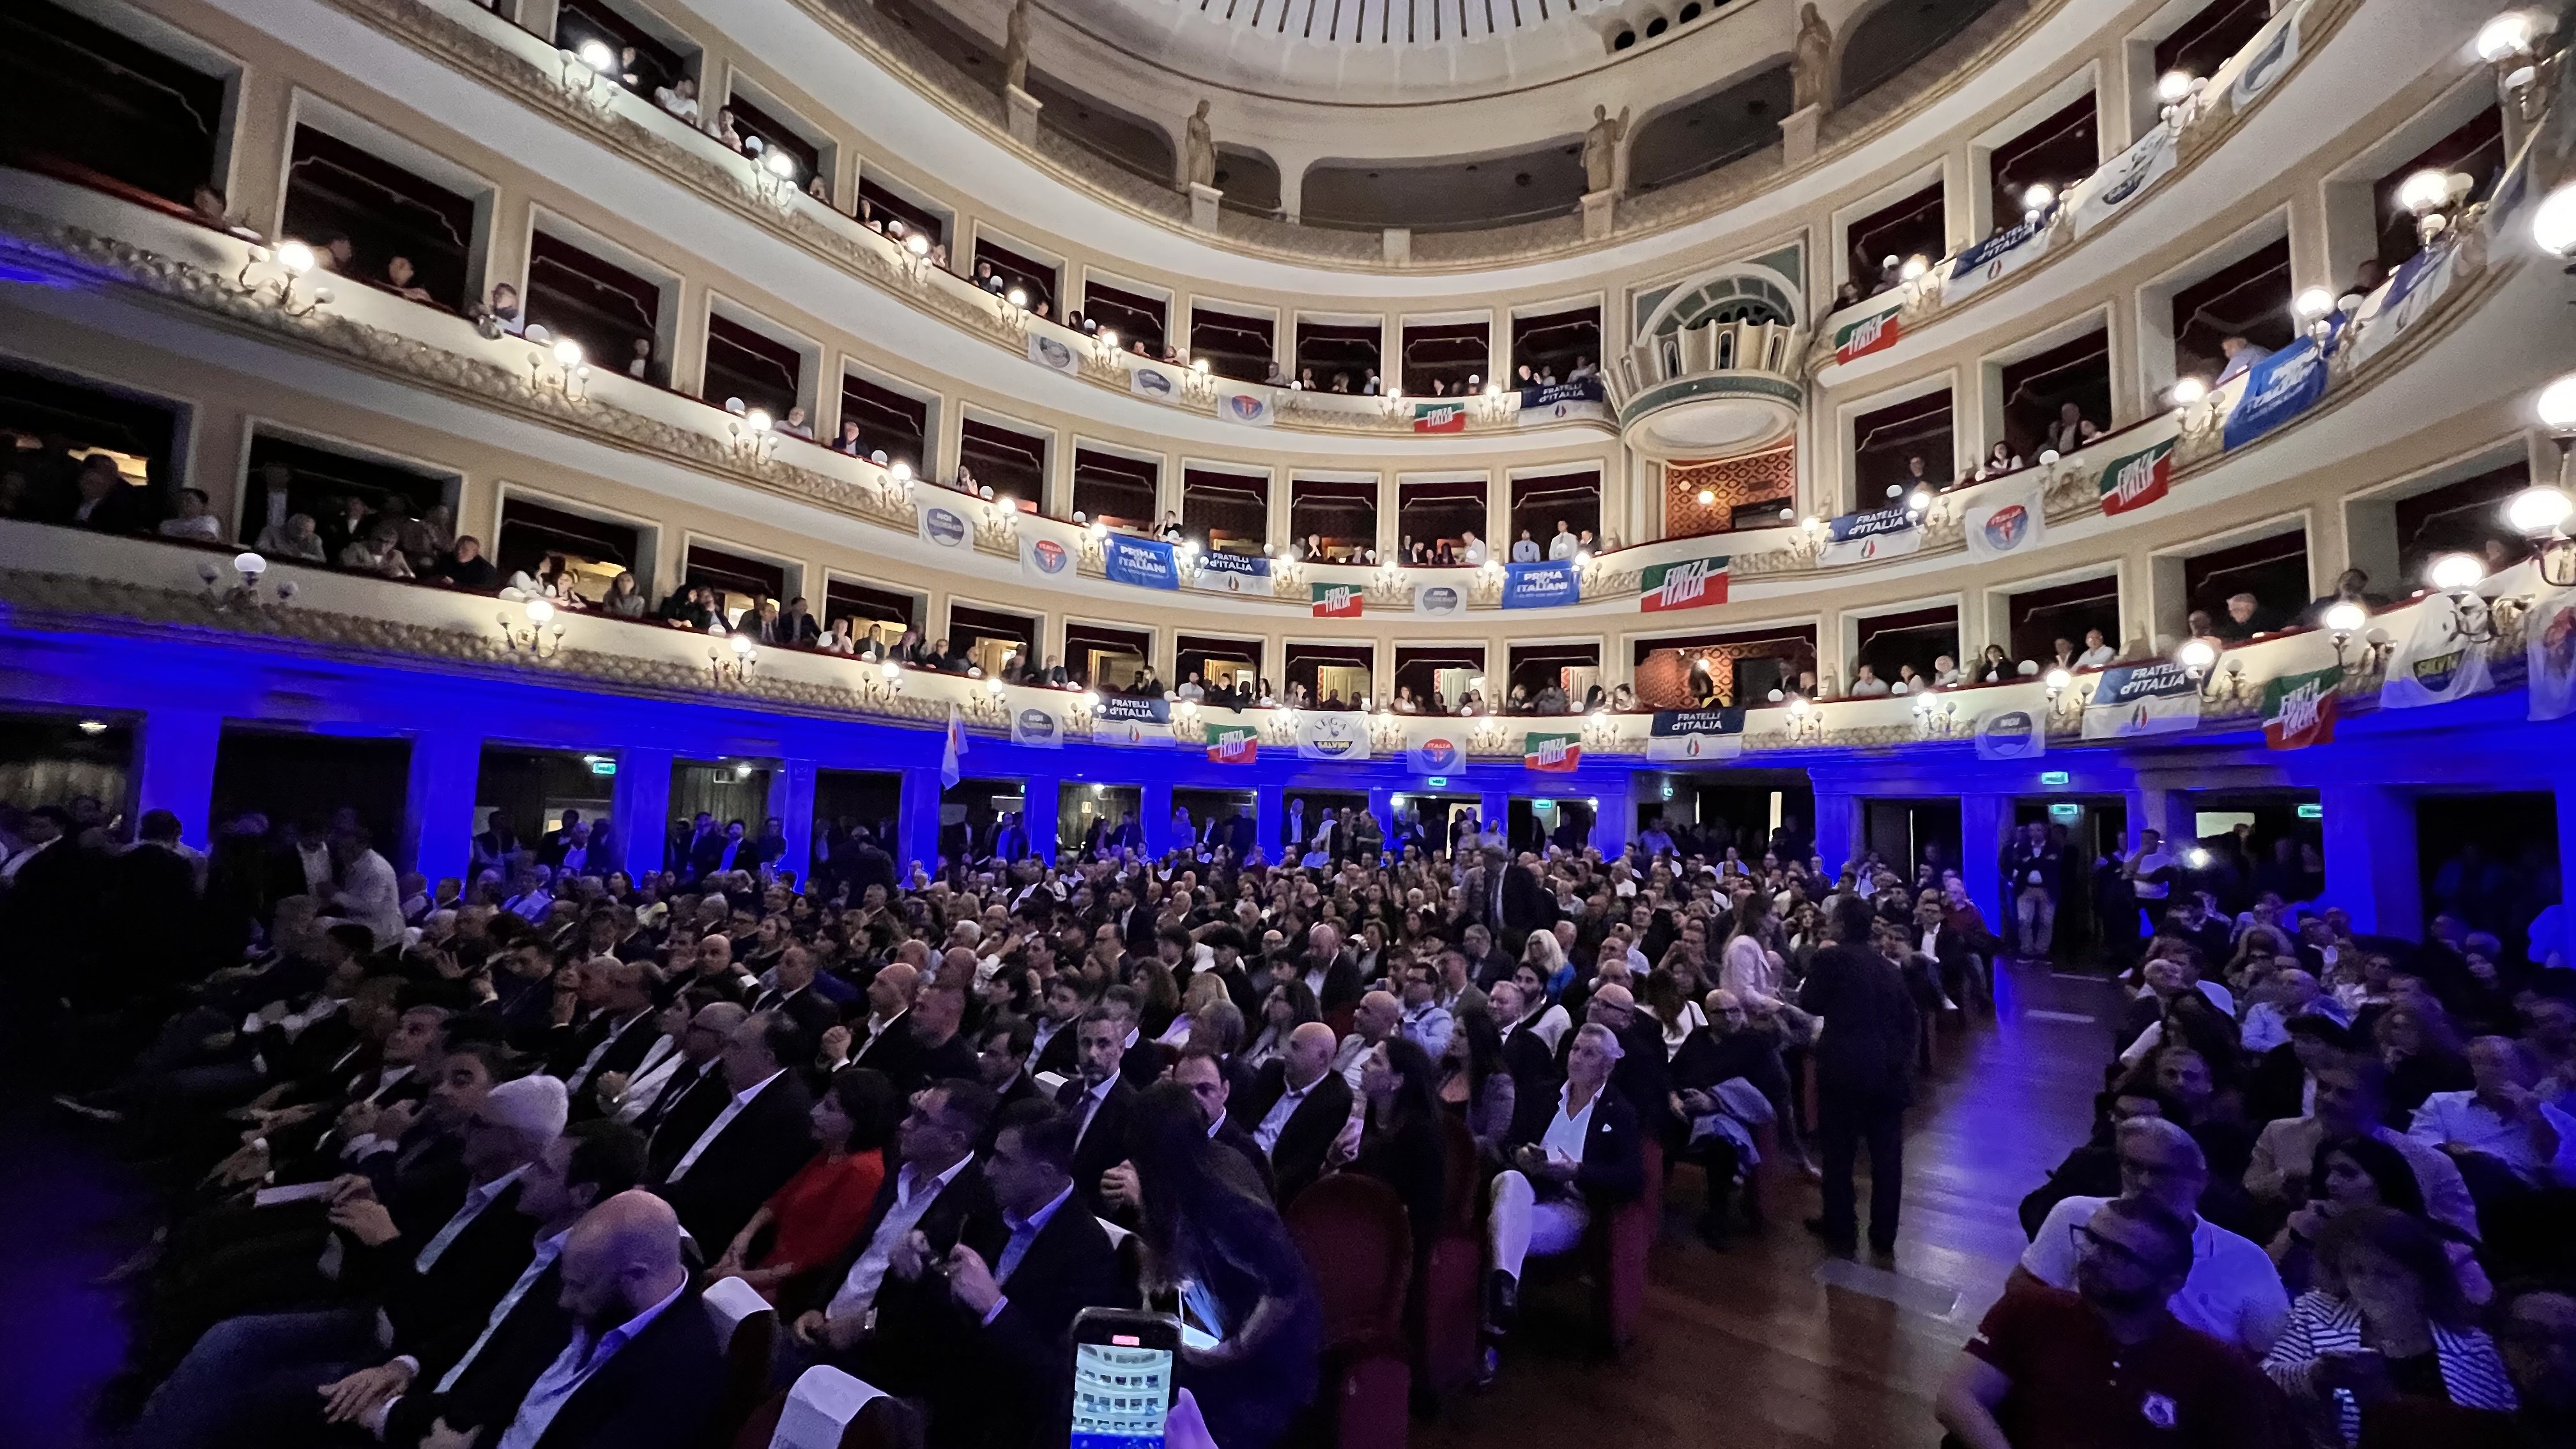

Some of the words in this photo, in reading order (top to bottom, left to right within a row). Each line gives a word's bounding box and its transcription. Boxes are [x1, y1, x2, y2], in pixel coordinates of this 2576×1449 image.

[1543, 383, 1583, 394] FRATELLI
[1538, 390, 1584, 402] d'ITALIA
[1856, 508, 1904, 524] FRATELLI
[1848, 516, 1904, 535] d'ITALIA
[1213, 553, 1249, 563] FRATELLI
[1209, 560, 1254, 571] d'ITALIA
[1524, 571, 1563, 581] PRIMA
[1664, 559, 1710, 587] FORZA
[1517, 582, 1568, 593] ITALIANI
[1660, 574, 1708, 607] ITALIA
[2120, 673, 2185, 694] d'ITALIA
[1112, 699, 1149, 709] FRATELLI
[1109, 707, 1154, 717] d'ITALIA
[1678, 712, 1721, 721] FRATELLI
[1314, 717, 1346, 730] LEGA
[1671, 720, 1722, 731] d'ITALIA
